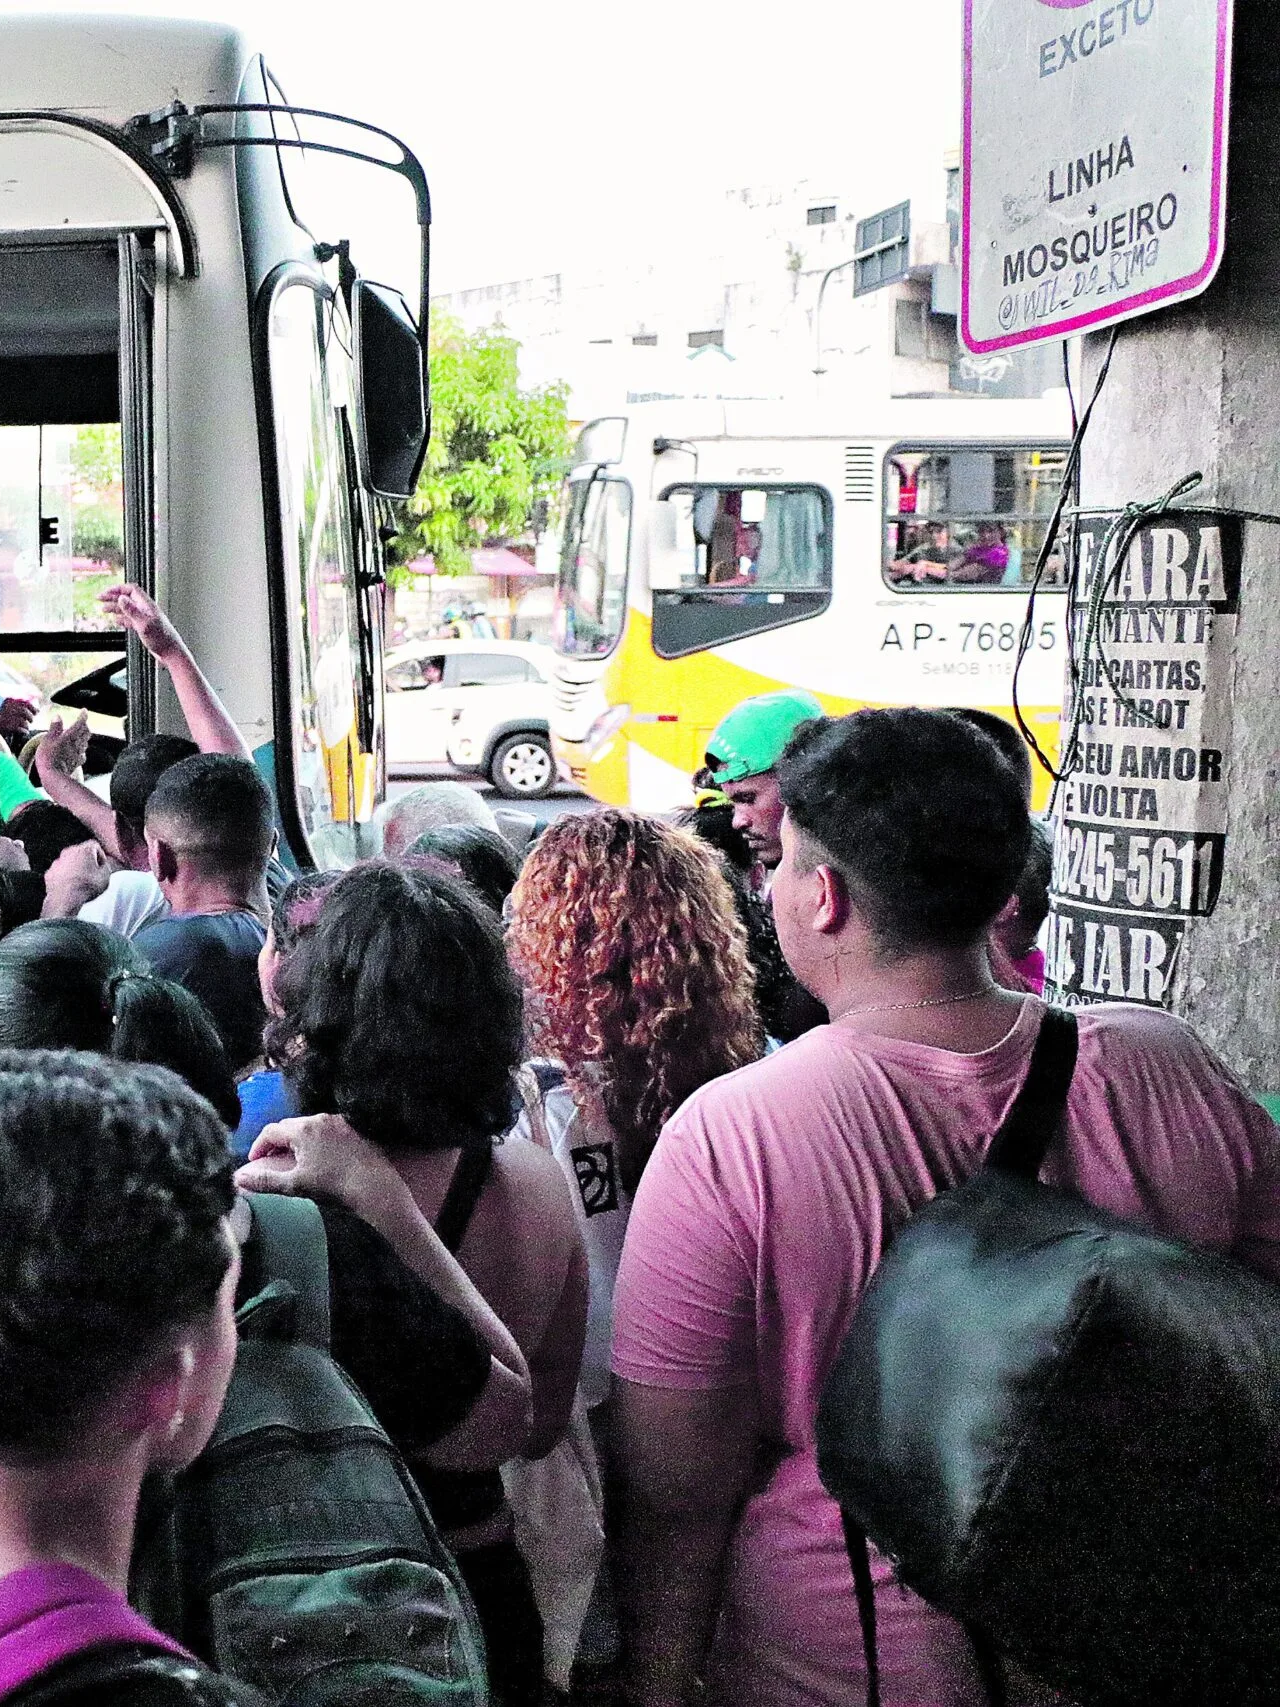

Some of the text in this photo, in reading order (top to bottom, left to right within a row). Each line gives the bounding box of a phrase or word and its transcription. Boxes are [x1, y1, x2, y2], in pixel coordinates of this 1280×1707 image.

[1038, 0, 1154, 79] EXCETO
[1048, 135, 1135, 203] LINHA
[1002, 192, 1178, 287] MOSQUEIRO
[880, 621, 1056, 652] AP-76805
[1099, 697, 1108, 726] E
[1113, 698, 1190, 730] TAROT
[1072, 741, 1222, 782] SEU AMOR
[1079, 782, 1159, 822] VOLTA
[1080, 921, 1184, 1001] IAR
